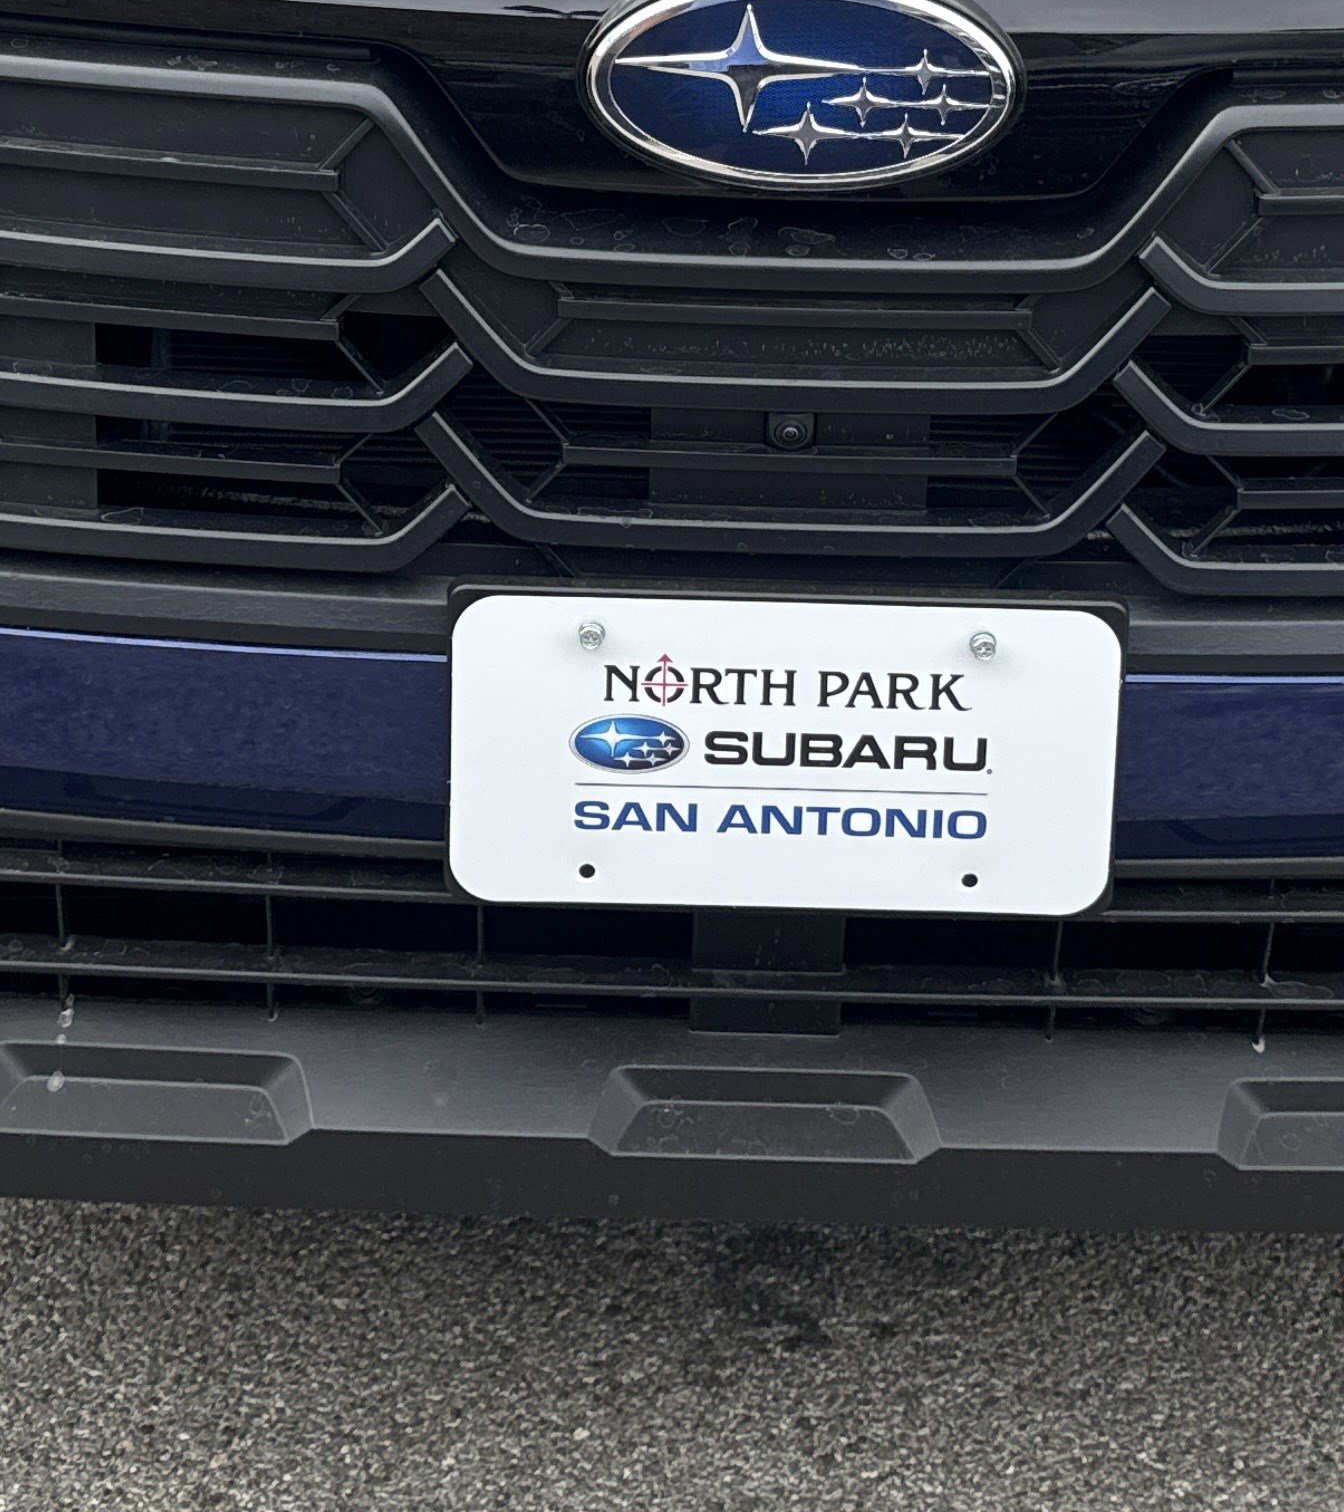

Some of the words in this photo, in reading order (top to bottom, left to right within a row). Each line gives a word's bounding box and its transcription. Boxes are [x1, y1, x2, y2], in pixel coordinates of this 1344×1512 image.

[602, 663, 796, 707] NORTH
[816, 669, 973, 712] PARK
[703, 729, 988, 773] SUBARU
[573, 799, 699, 833] SAN
[716, 804, 988, 840] ANTONIO
